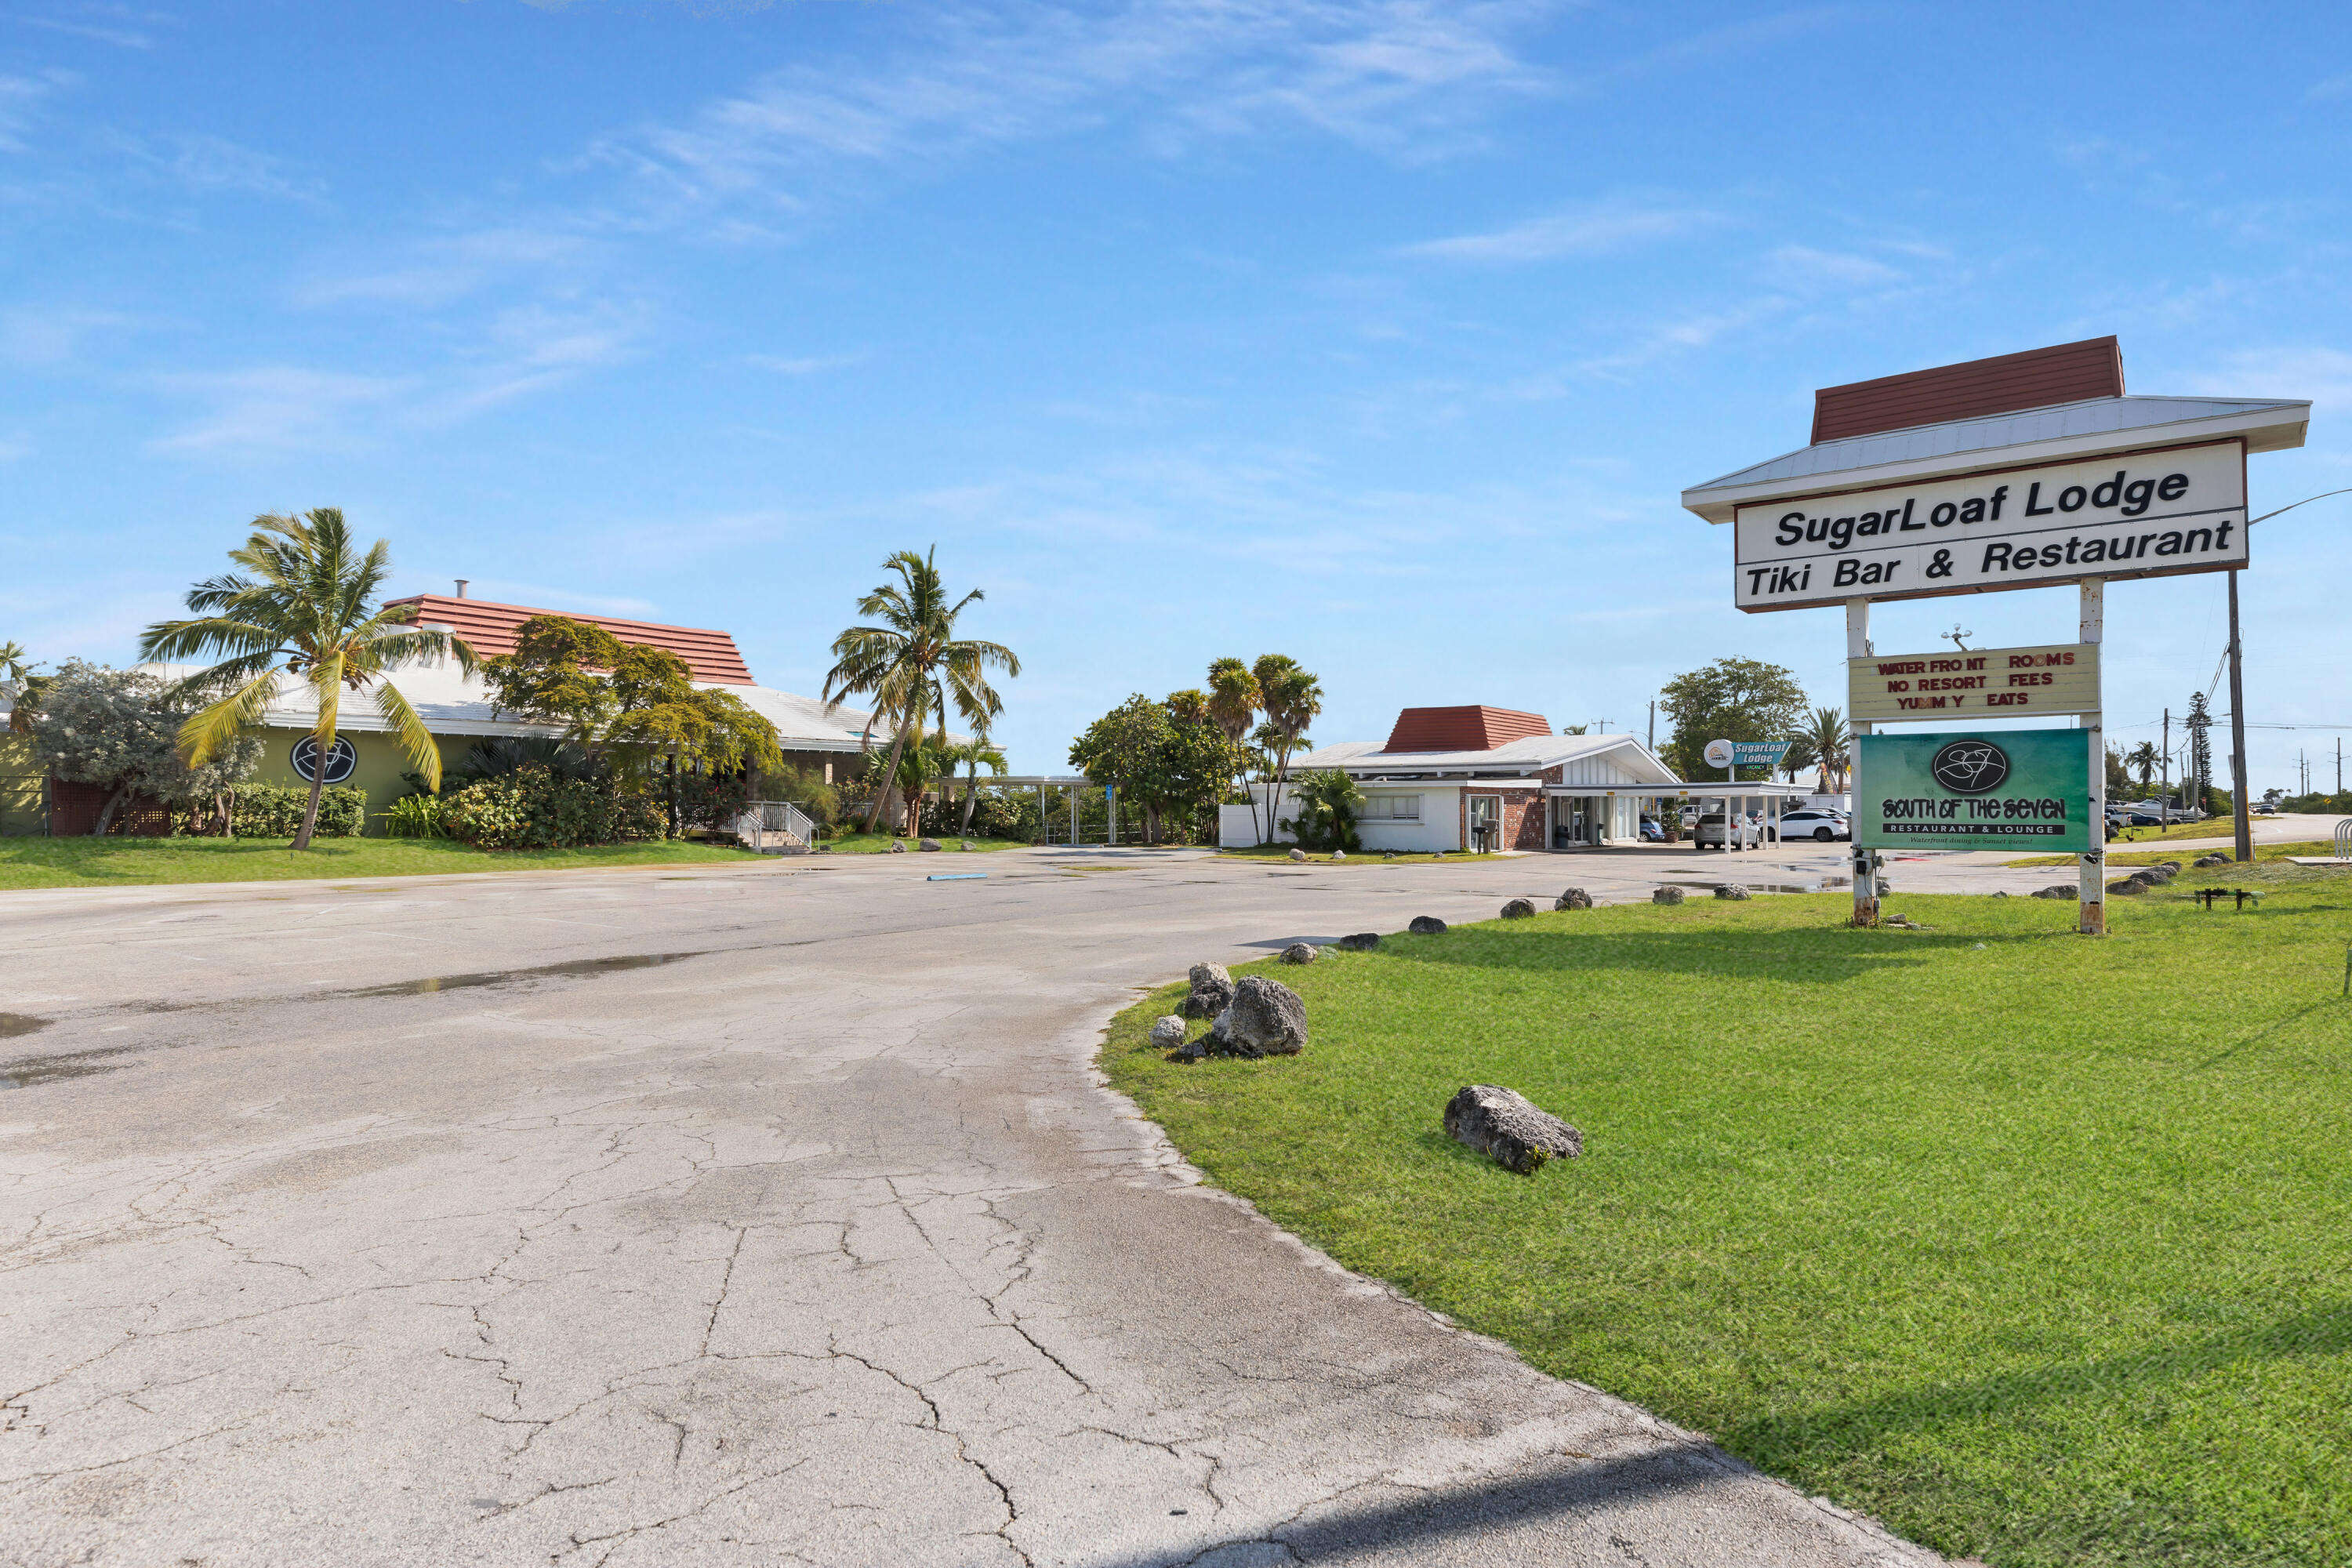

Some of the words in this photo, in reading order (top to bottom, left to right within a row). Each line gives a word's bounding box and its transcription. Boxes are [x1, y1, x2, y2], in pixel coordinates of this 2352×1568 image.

[1775, 485, 2009, 550] SugarLoaf
[2024, 470, 2189, 517] Lodge
[1747, 564, 1811, 596] Tiki
[1833, 558, 1901, 588] Bar
[1926, 548, 1955, 579] &
[1981, 520, 2234, 573] Restaurant
[2009, 652, 2075, 669] ROOMS
[1887, 680, 1909, 693] NO
[1918, 675, 1987, 691] RESORT
[2009, 672, 2053, 687] FEES
[1987, 692, 2028, 706] EATS
[1735, 743, 1786, 753] SugarLoaf
[1743, 753, 1773, 763] Lodge
[1882, 798, 1936, 819] SOUTH
[1939, 798, 1962, 819] OF
[1890, 824, 1975, 833] RESTAURANT
[1982, 825, 1990, 833] &
[1997, 826, 2054, 834] LOUNGE
[1949, 837, 1973, 845] dining
